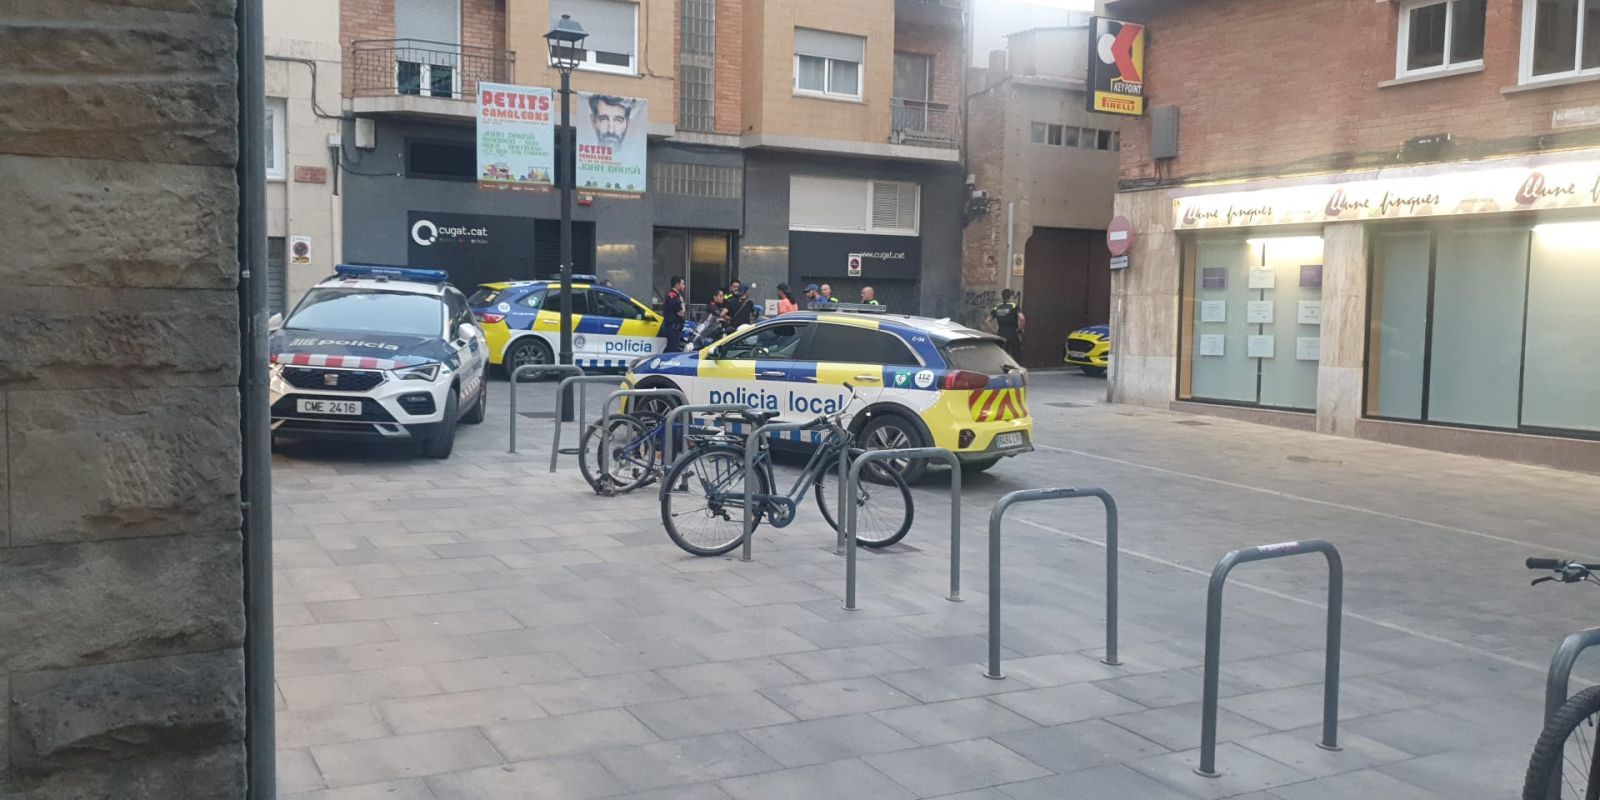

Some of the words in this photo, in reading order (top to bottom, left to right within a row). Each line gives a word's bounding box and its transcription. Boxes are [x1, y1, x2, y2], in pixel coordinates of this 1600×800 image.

[481, 91, 549, 111] PETITS
[1102, 96, 1136, 111] PIRELLI
[482, 108, 549, 121] CAMALEONS
[578, 144, 613, 155] PETITS
[1379, 191, 1441, 215] finques
[438, 226, 489, 238] cugat.cat
[318, 339, 400, 351] policia
[605, 340, 652, 353] policia
[917, 373, 931, 381] 112
[304, 400, 325, 412] CME
[328, 402, 357, 413] 2416
[709, 387, 778, 410] policia
[788, 390, 844, 415] local
